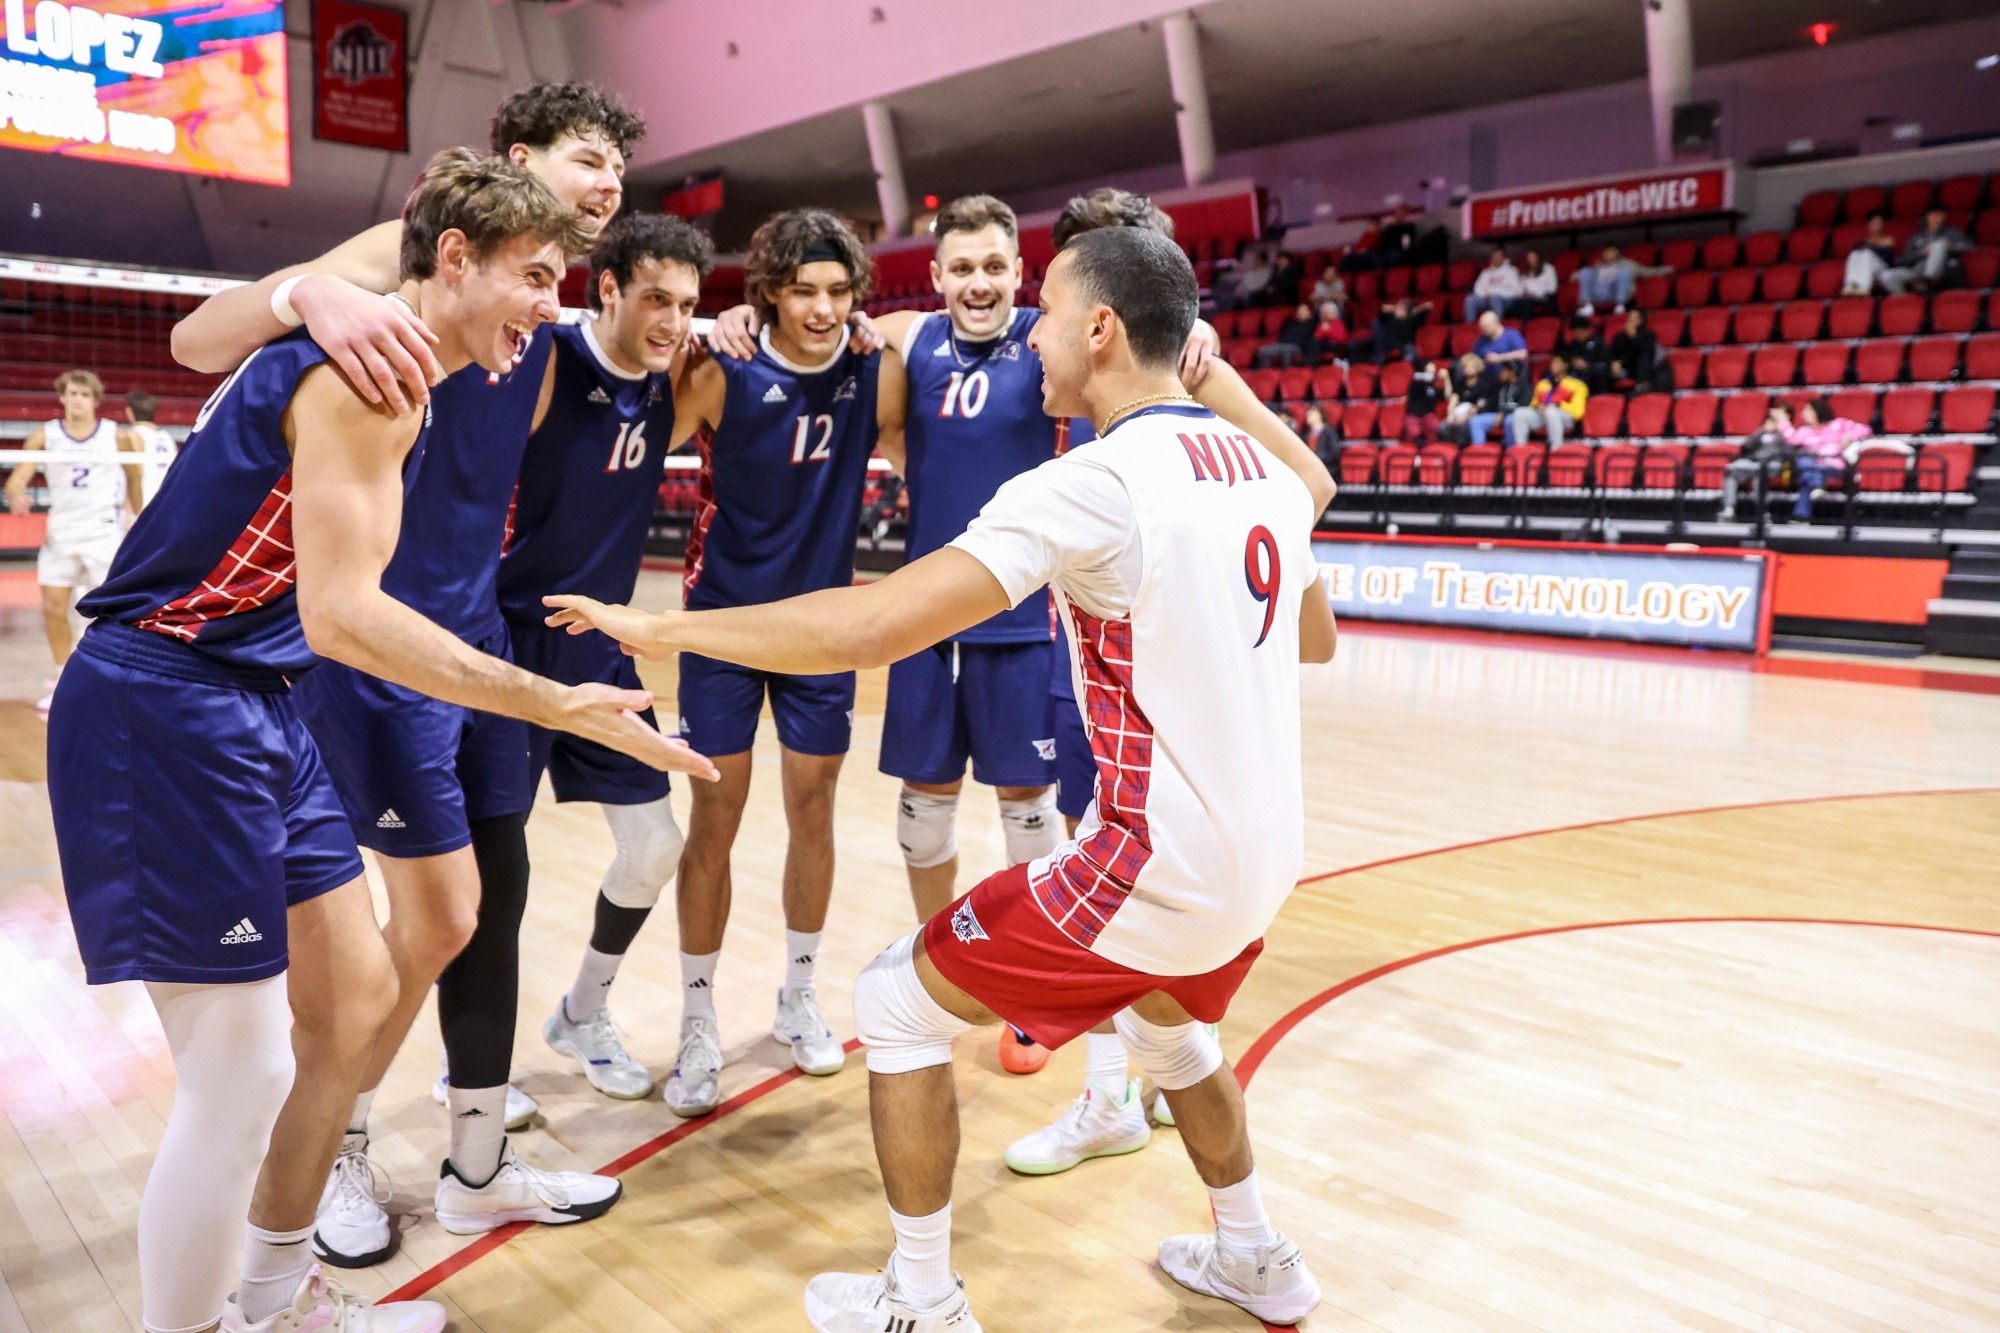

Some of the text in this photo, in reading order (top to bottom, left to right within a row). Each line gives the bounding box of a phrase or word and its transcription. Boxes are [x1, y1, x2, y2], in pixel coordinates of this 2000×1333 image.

[5, 0, 164, 78] LOPEZ
[1491, 177, 1699, 228] #ProtectTheWEC
[938, 370, 990, 419] 10
[604, 420, 647, 473] 16
[789, 413, 834, 465] 12
[1176, 433, 1268, 488] NJIT
[72, 466, 90, 489] 2
[1244, 524, 1281, 649] 9
[1360, 565, 1418, 606] OF
[220, 933, 263, 944] adidas
